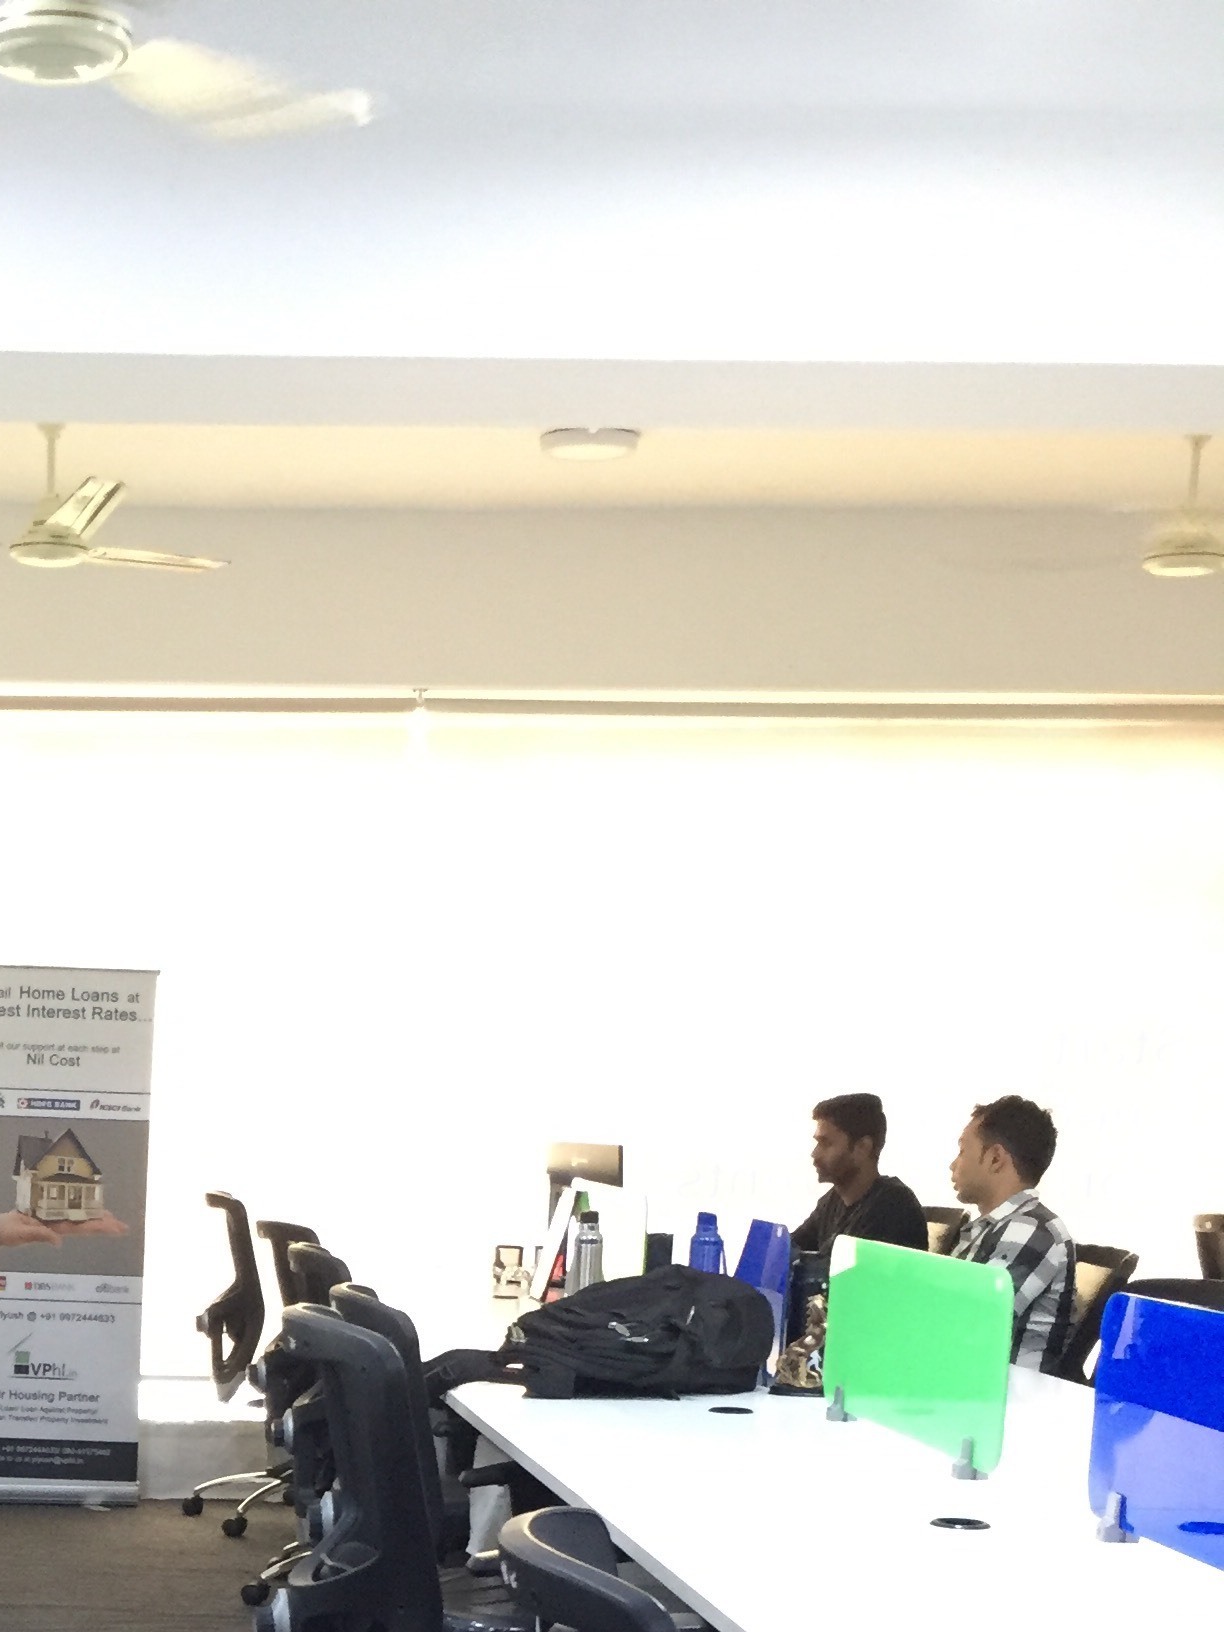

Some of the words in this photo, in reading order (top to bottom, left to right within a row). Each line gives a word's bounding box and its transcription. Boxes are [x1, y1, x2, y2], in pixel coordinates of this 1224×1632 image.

[19, 986, 66, 1001] Home
[71, 987, 119, 1002] Loans
[127, 992, 140, 1003] at
[26, 1005, 86, 1019] Interest
[26, 1053, 44, 1065] Nil
[49, 1053, 81, 1067] Cost
[9, 1390, 55, 1403] Housing
[58, 1391, 100, 1402] Partner
